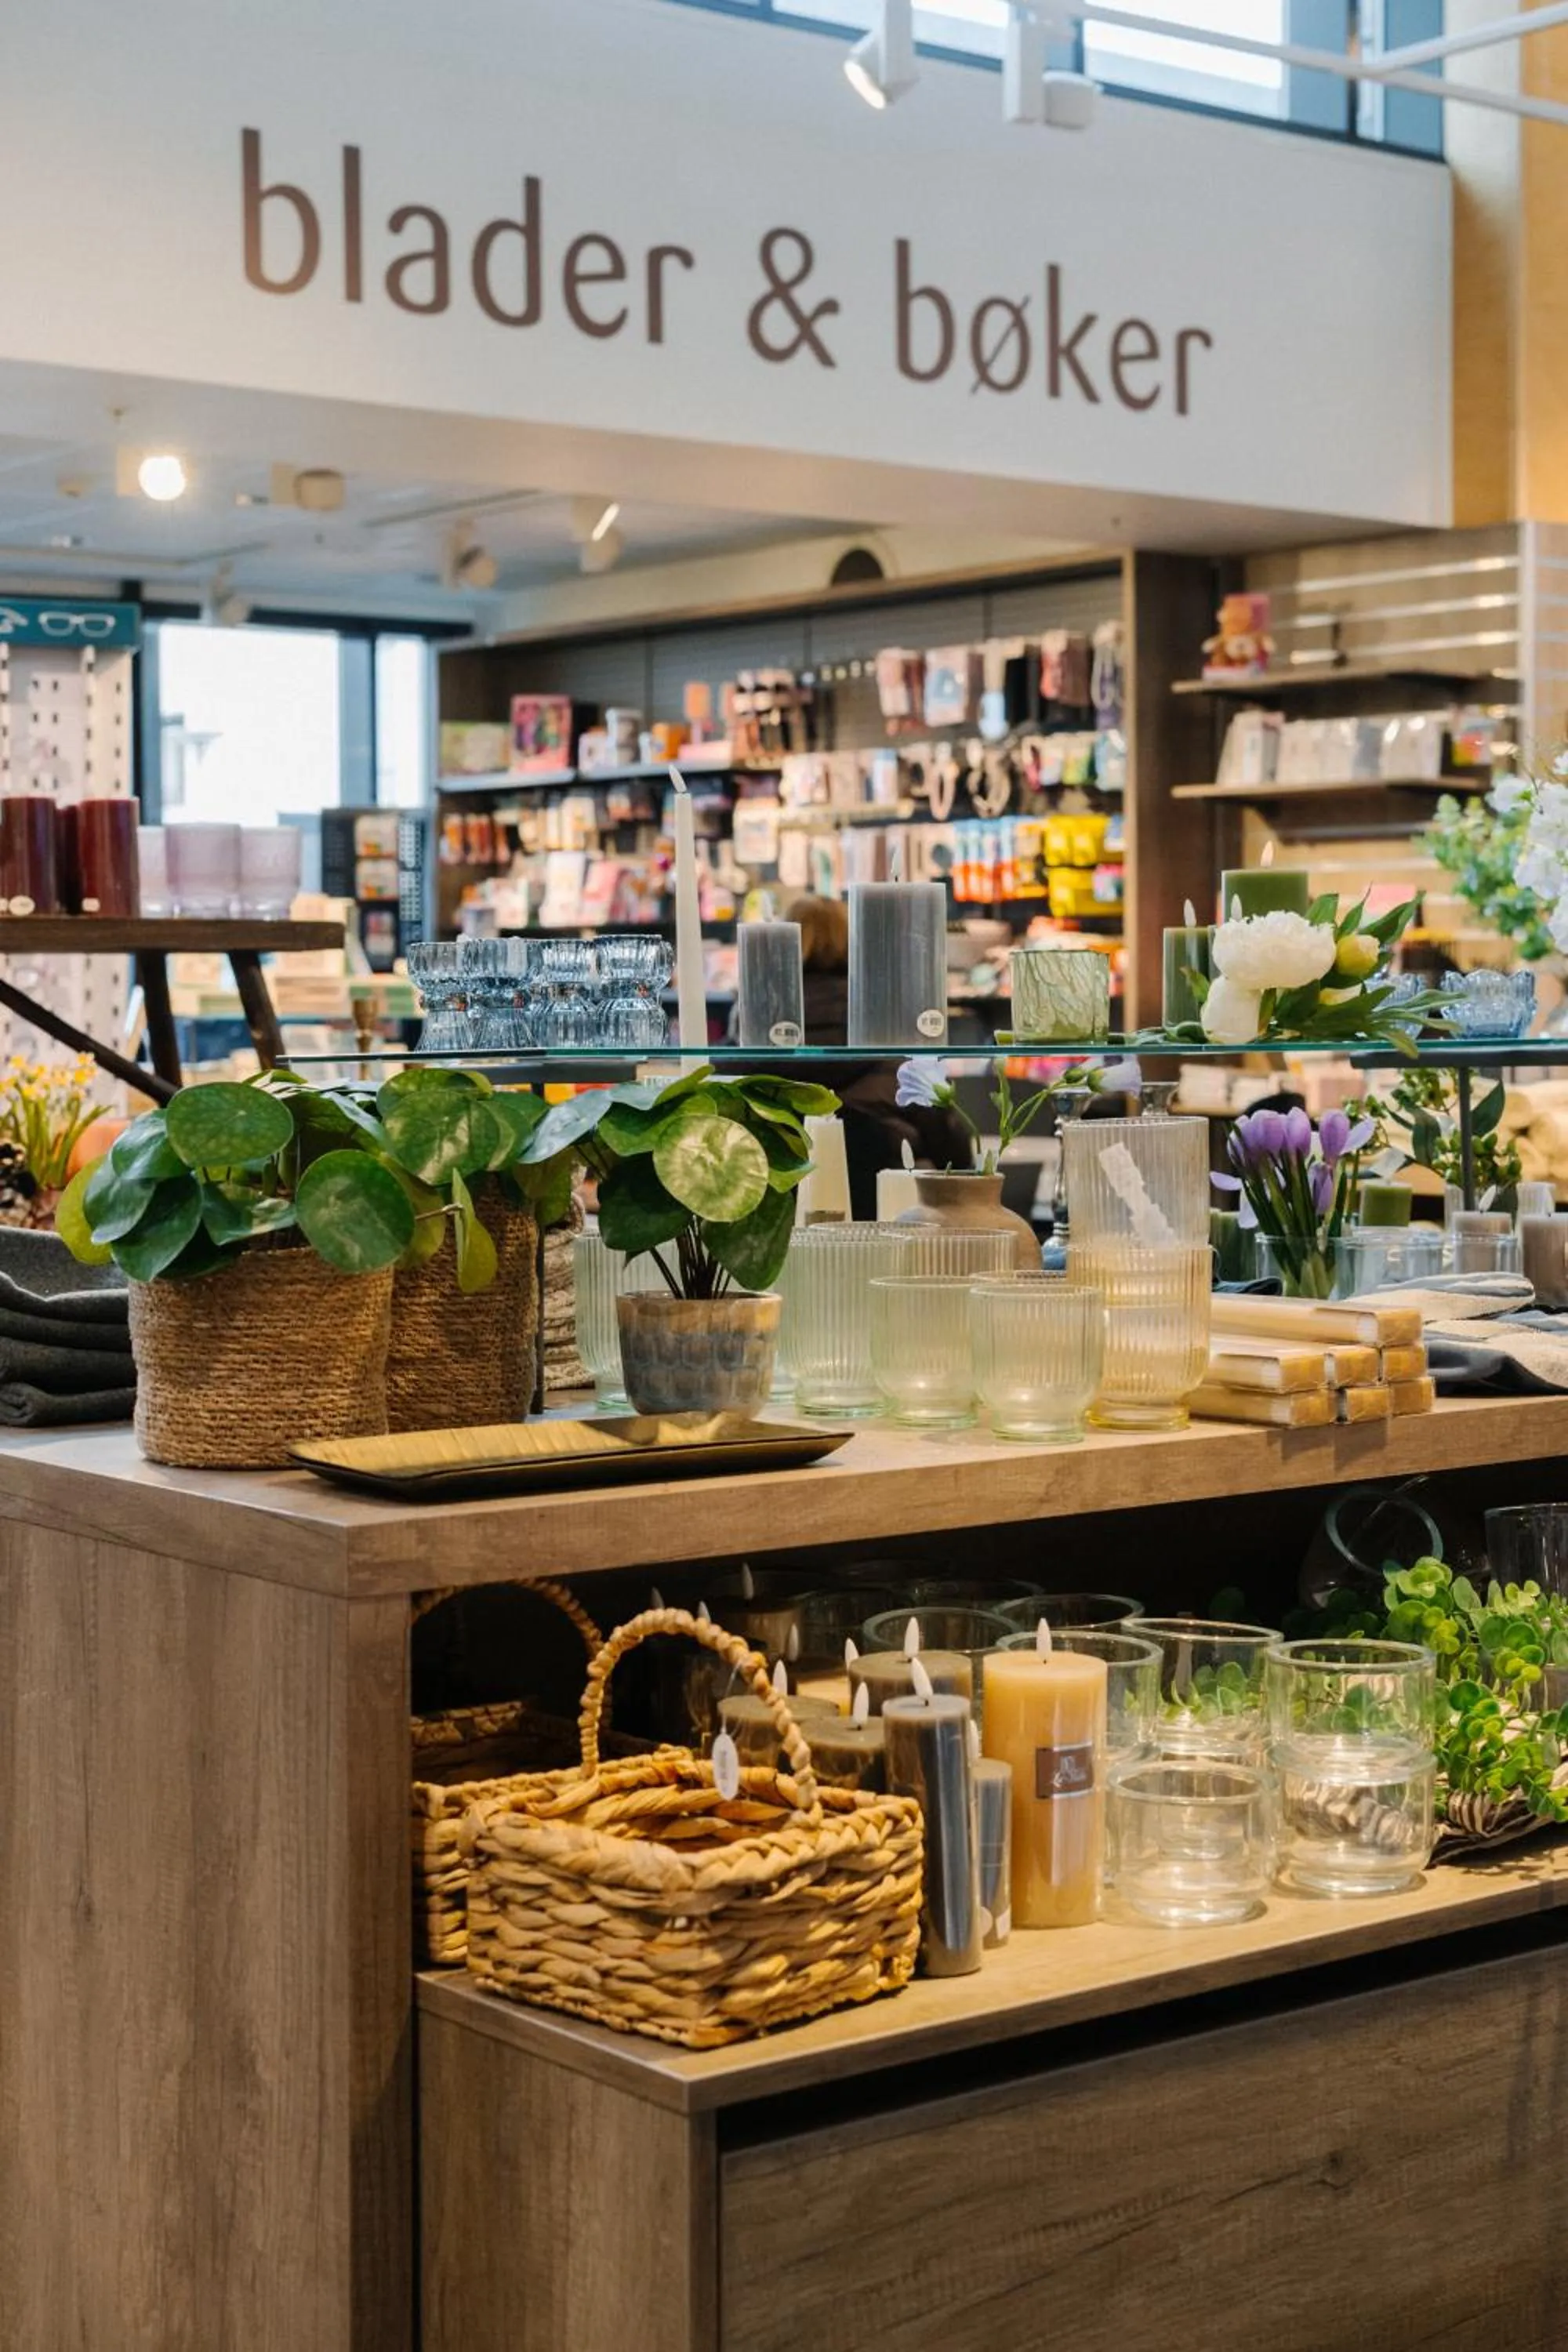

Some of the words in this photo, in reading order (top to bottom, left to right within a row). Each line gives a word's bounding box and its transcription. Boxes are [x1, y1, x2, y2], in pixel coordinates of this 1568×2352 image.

[240, 126, 695, 345] blader
[746, 226, 841, 369] &
[895, 237, 1214, 418] bøker
